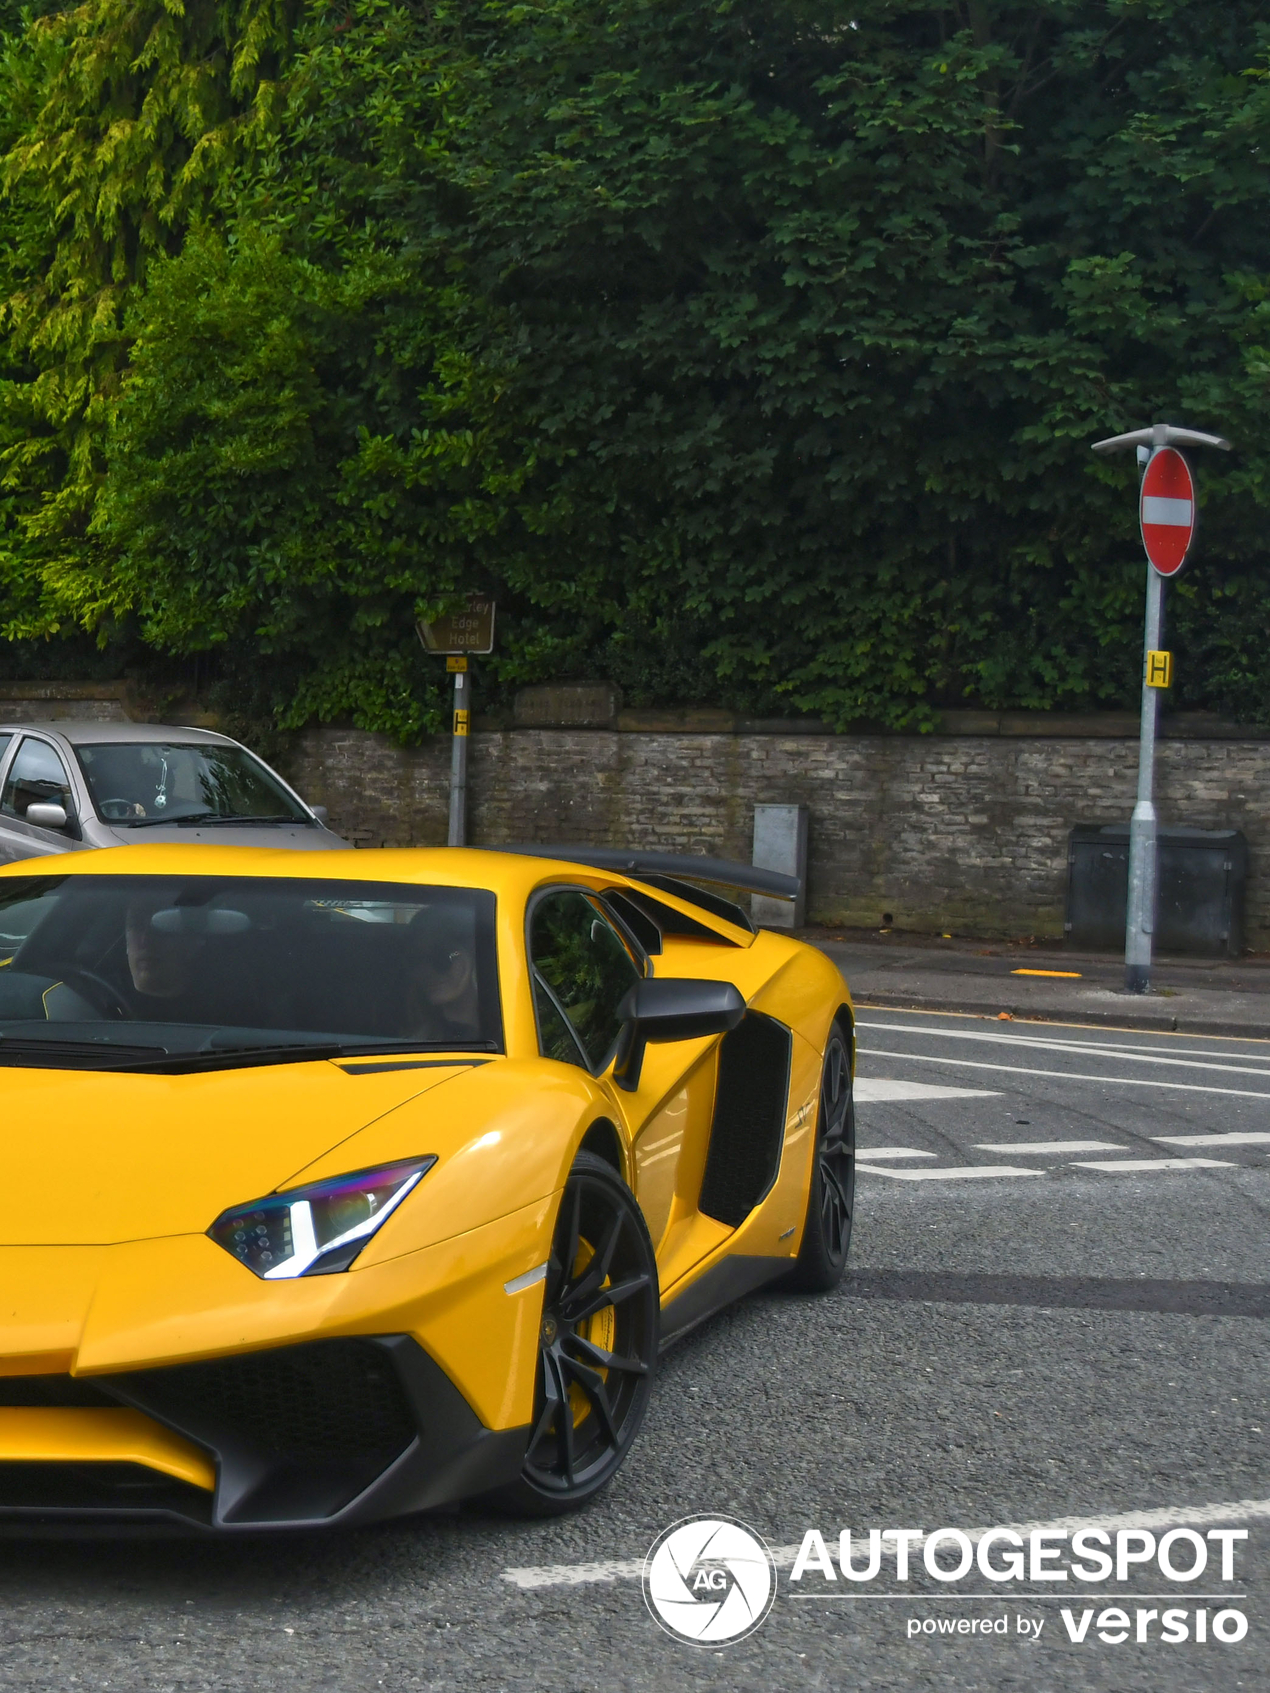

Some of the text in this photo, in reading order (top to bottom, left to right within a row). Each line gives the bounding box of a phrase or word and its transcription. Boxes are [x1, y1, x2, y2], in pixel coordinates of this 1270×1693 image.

[451, 616, 479, 631] Edge
[449, 632, 480, 645] Hotel
[1150, 654, 1167, 684] H
[454, 712, 469, 732] H
